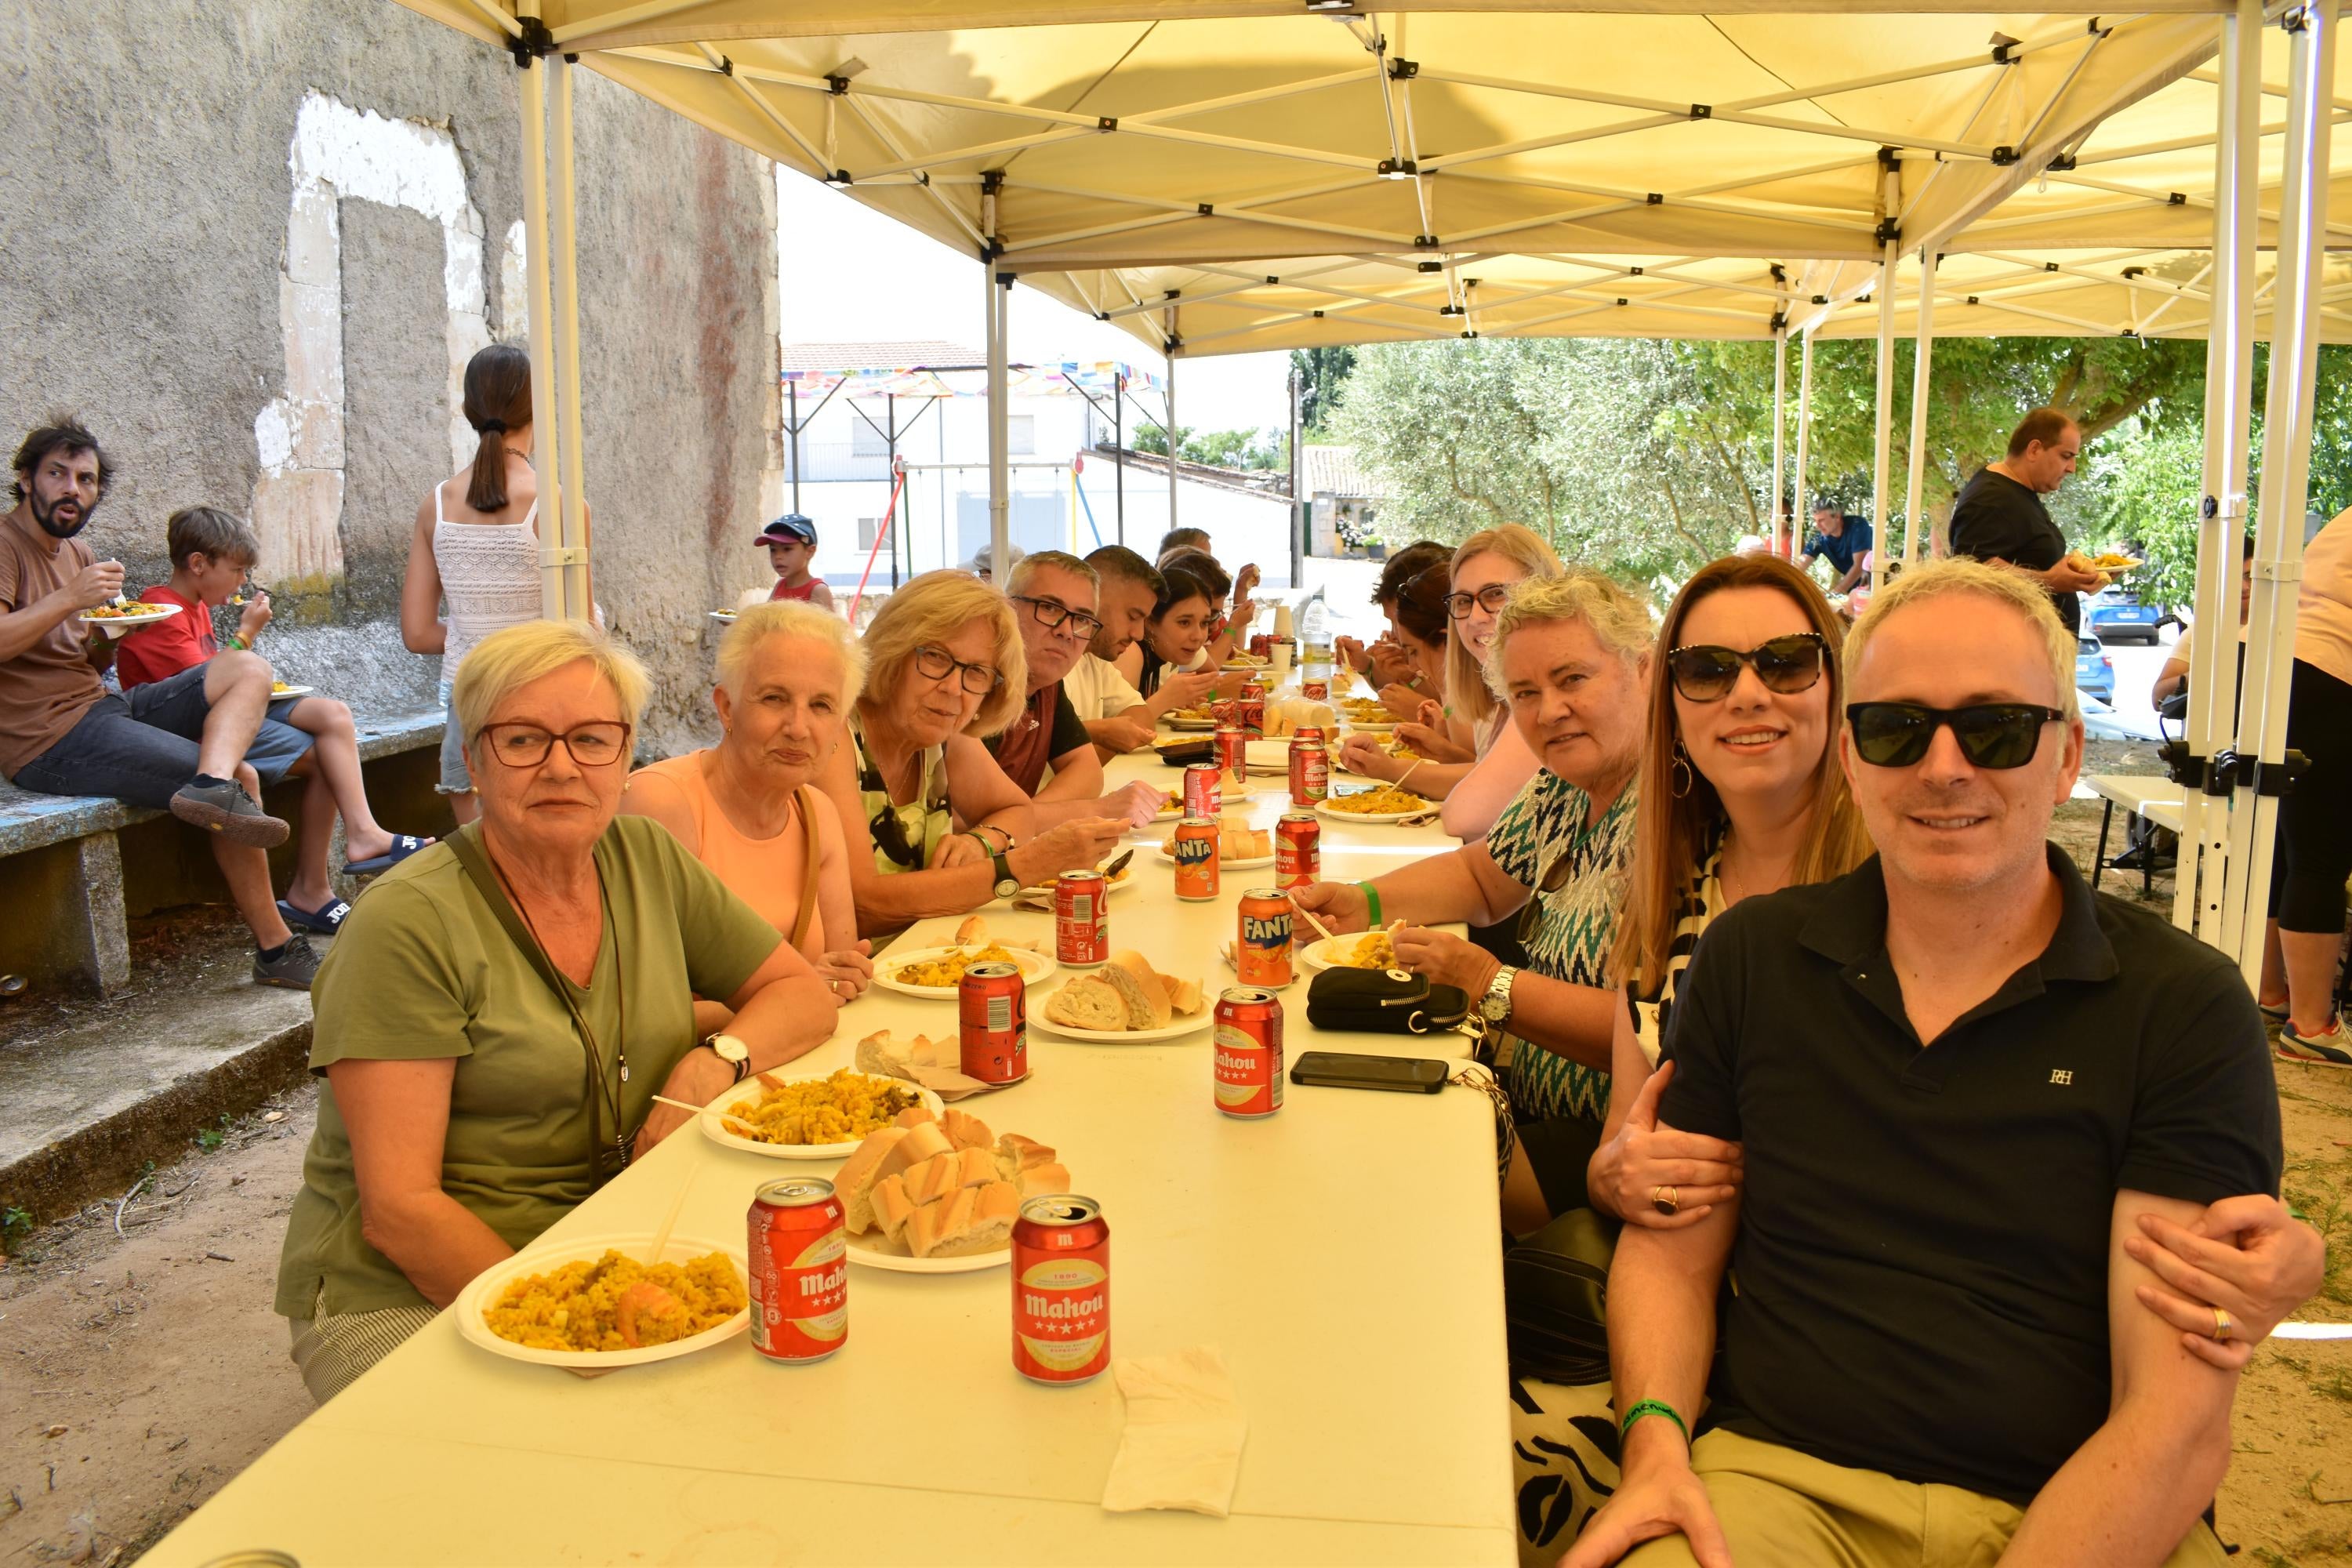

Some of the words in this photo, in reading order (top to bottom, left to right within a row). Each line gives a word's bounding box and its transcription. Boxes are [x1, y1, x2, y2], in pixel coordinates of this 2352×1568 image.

[402, 835, 417, 850] JO
[1176, 839, 1212, 858] ANTA
[1276, 852, 1295, 864] hou
[1025, 1294, 1104, 1319] Mahou
